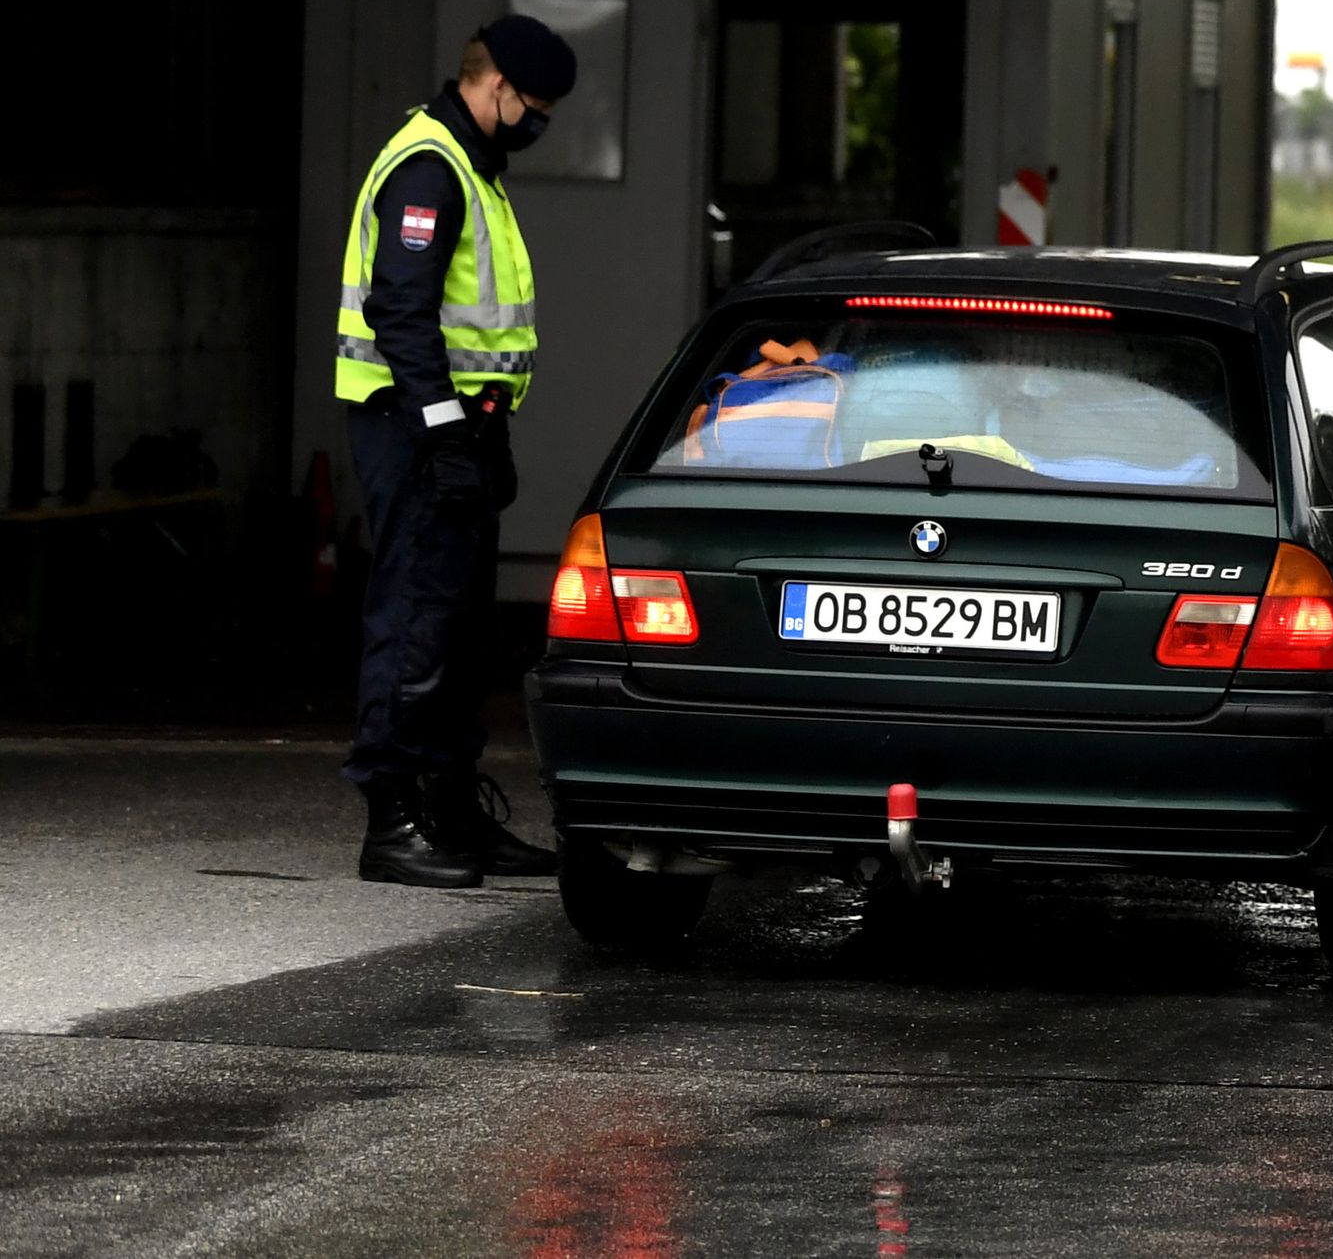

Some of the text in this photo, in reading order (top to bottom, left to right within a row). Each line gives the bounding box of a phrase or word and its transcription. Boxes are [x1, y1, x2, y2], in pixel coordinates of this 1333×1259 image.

[1141, 562, 1243, 579] 320 d
[784, 618, 803, 631] BG
[813, 592, 1049, 643] OB 8529 BM
[889, 644, 930, 654] Reisacher
